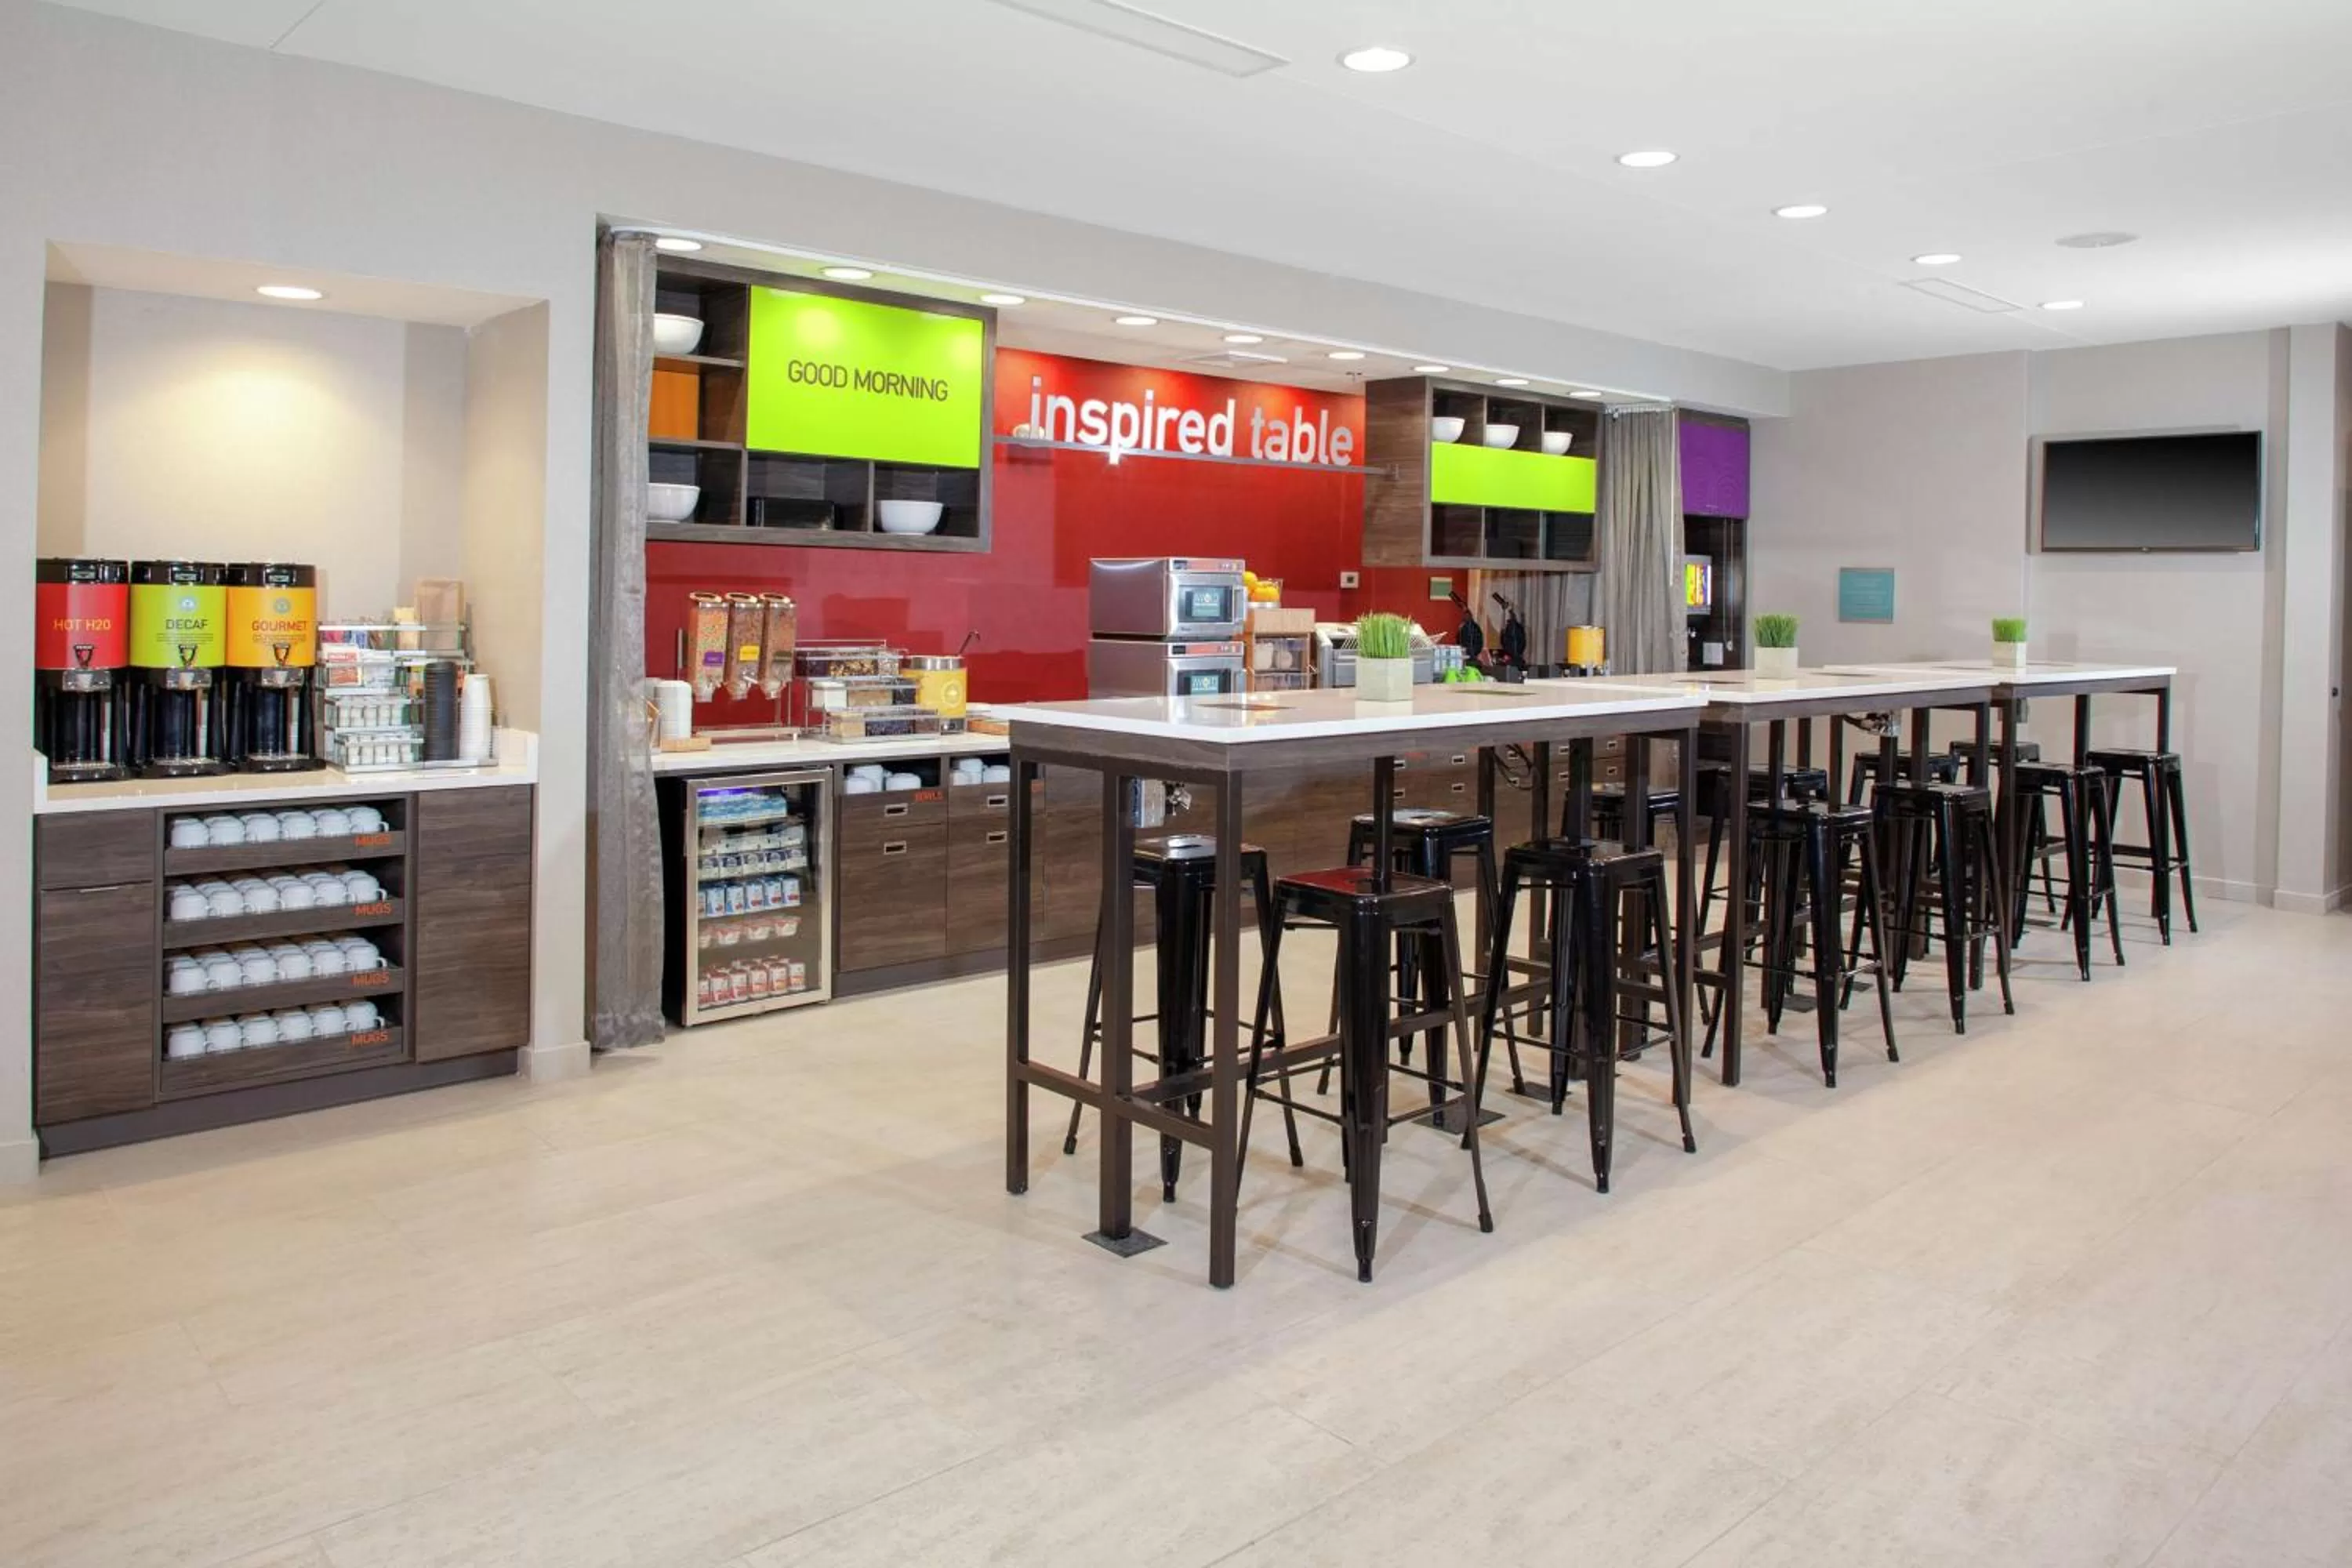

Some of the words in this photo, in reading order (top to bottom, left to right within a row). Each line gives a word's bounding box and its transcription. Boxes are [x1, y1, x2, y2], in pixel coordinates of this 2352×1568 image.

[788, 360, 848, 388] GOOD
[854, 368, 948, 401] MORNING
[1030, 376, 1236, 465] inspired
[1250, 405, 1353, 466] table
[53, 619, 82, 631] HOT
[165, 619, 209, 630] DECAF
[252, 620, 307, 632] GOURMET
[354, 902, 392, 916] MUGS
[351, 971, 390, 986] MUGS
[351, 1030, 389, 1047] MUGS
